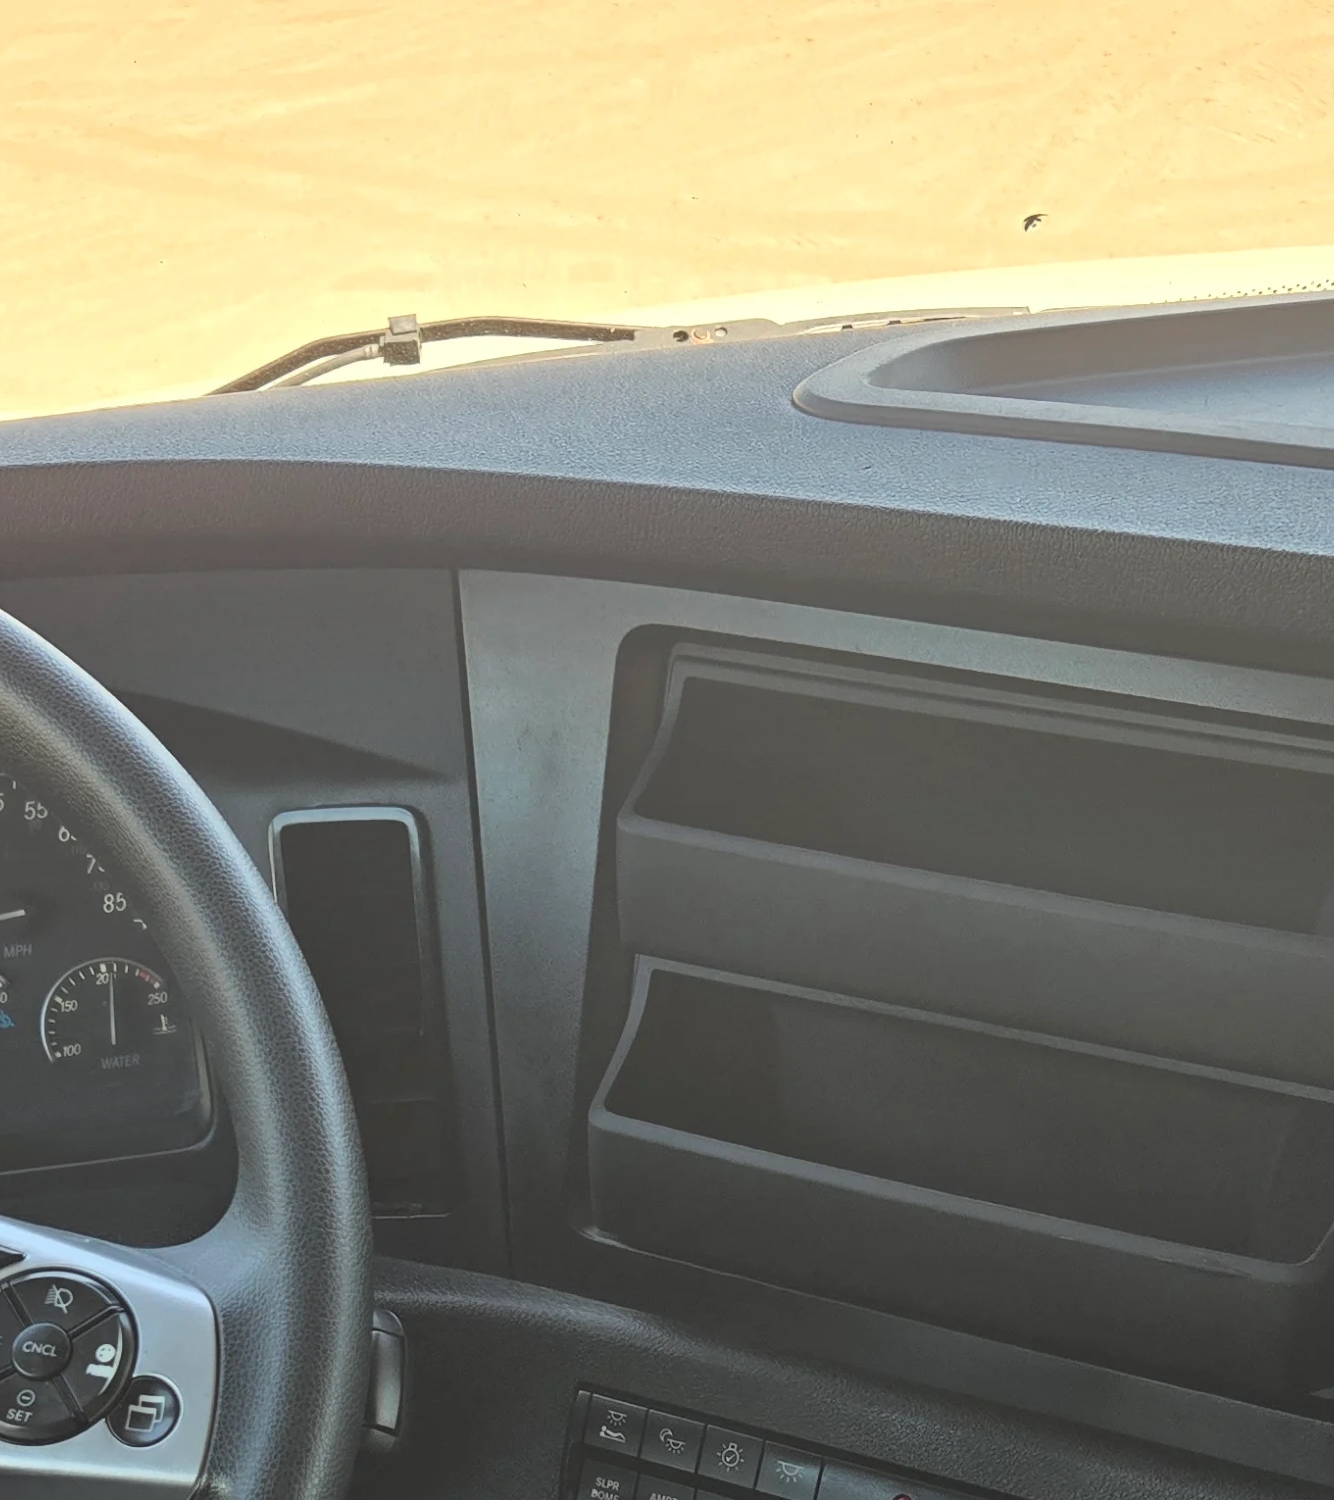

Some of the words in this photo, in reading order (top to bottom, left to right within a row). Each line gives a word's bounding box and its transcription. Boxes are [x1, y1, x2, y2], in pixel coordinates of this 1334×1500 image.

[24, 802, 48, 819] 55
[103, 893, 126, 913] 85
[4, 944, 32, 958] MPH
[61, 1000, 78, 1012] 150
[148, 992, 167, 1006] 250
[63, 1044, 81, 1057] 100
[101, 1054, 140, 1069] WATER
[22, 1340, 57, 1357] CNCL
[6, 1409, 33, 1423] SET
[595, 1477, 620, 1491] SLPR
